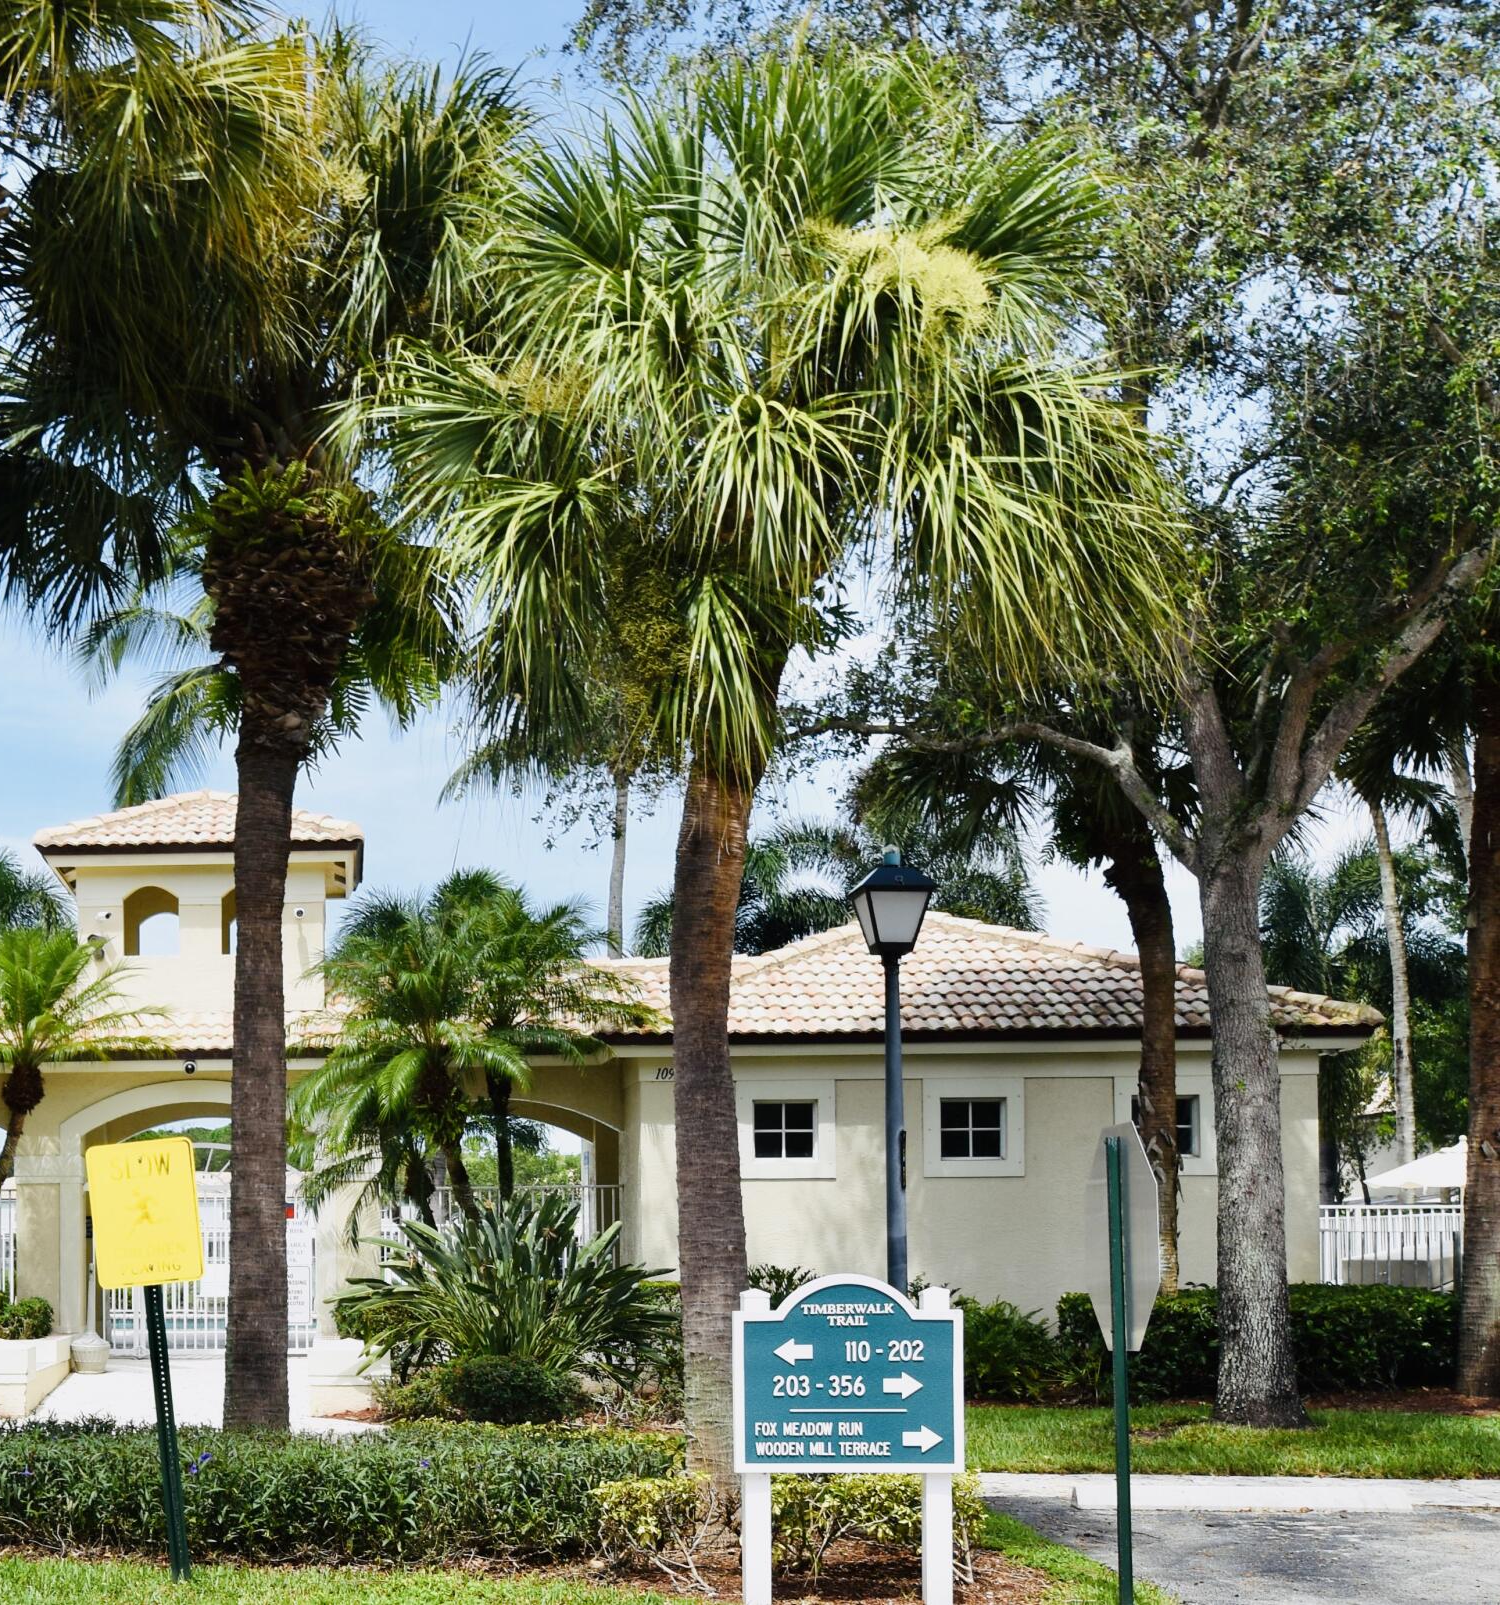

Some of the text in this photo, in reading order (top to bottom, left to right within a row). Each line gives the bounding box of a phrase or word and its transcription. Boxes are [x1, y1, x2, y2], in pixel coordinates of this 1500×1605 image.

[801, 1303, 895, 1315] TIMBERWALK
[827, 1315, 868, 1327] TRAIL
[845, 1341, 871, 1362] 110
[888, 1340, 925, 1361] 202
[773, 1375, 811, 1397] 203
[828, 1375, 866, 1397] 356
[755, 1422, 863, 1436] FOX MEADOW RUN
[756, 1442, 891, 1456] WOODEN MILL TERRACE
